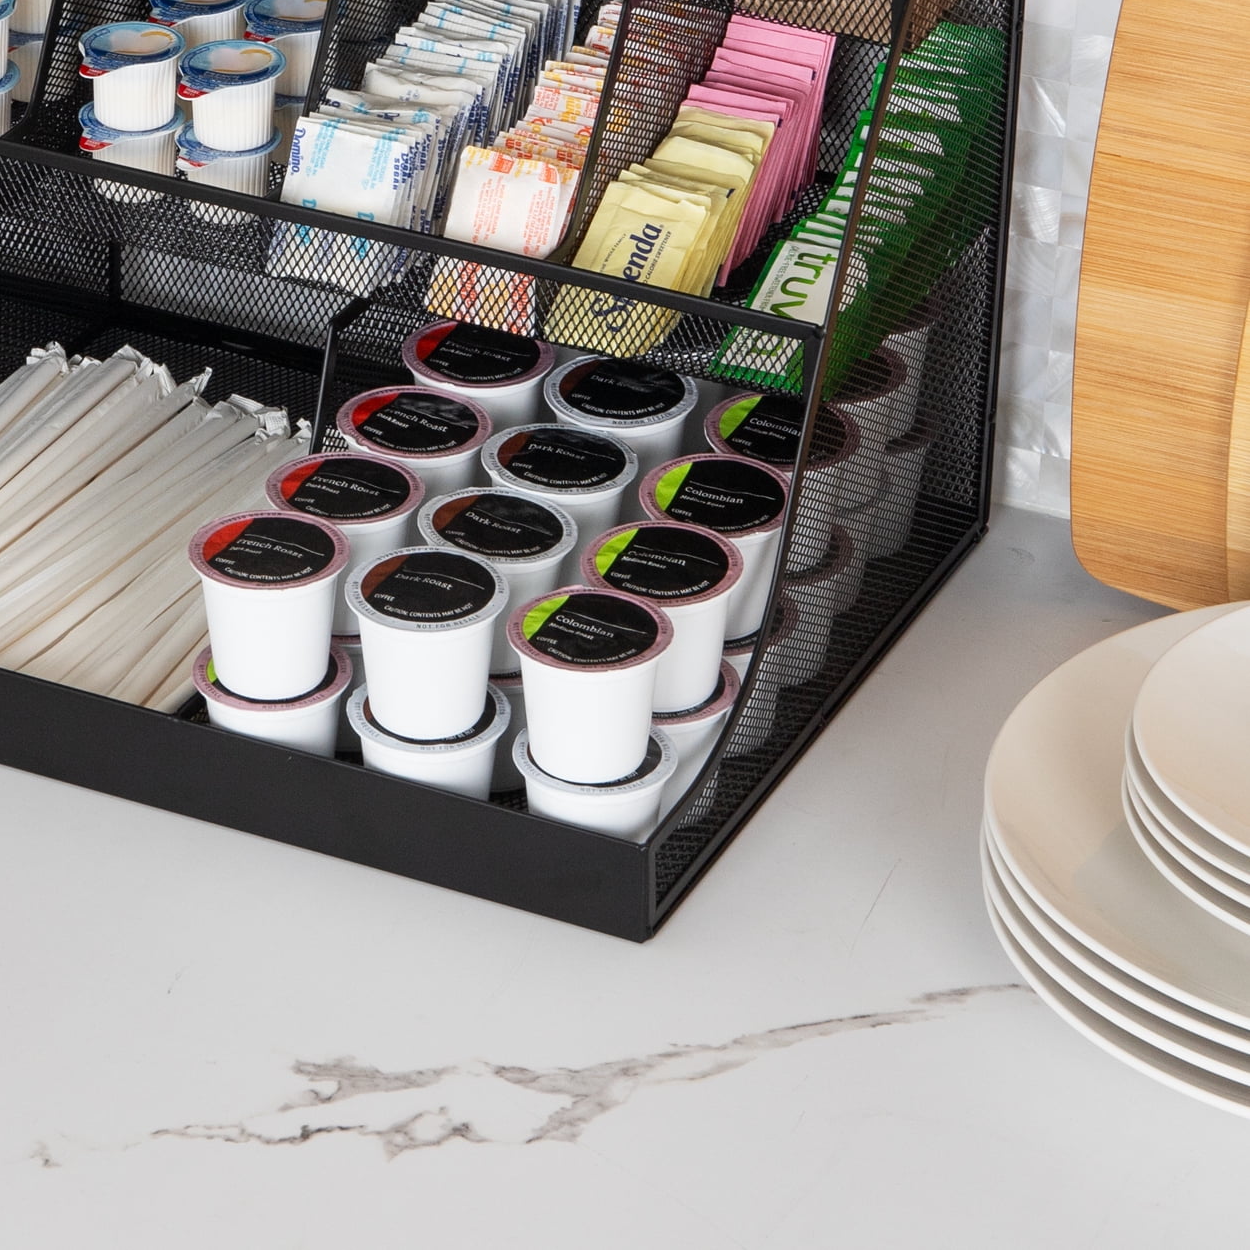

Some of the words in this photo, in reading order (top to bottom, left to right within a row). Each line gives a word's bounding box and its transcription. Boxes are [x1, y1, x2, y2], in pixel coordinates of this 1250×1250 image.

[291, 128, 306, 174] Domino
[392, 157, 401, 191] SUGAR
[590, 375, 615, 385] Dark
[419, 417, 449, 433] Roast
[528, 443, 555, 454] Dark
[732, 437, 752, 446] COFFEE
[312, 475, 349, 488] French
[349, 483, 381, 497] Roast
[684, 486, 744, 505] Colombian
[465, 511, 491, 526] Dark
[671, 507, 692, 517] COFFEE
[273, 545, 304, 559] Roast
[627, 550, 687, 566] Colombian
[395, 573, 423, 584] Dark
[424, 577, 453, 591] Roast
[374, 593, 396, 601] COFFEE
[680, 587, 693, 595] MAY
[454, 607, 463, 615] BE
[462, 602, 473, 611] HOT
[453, 614, 480, 626] RESALE
[555, 614, 614, 638] Colombian
[536, 636, 558, 645] COFFEE
